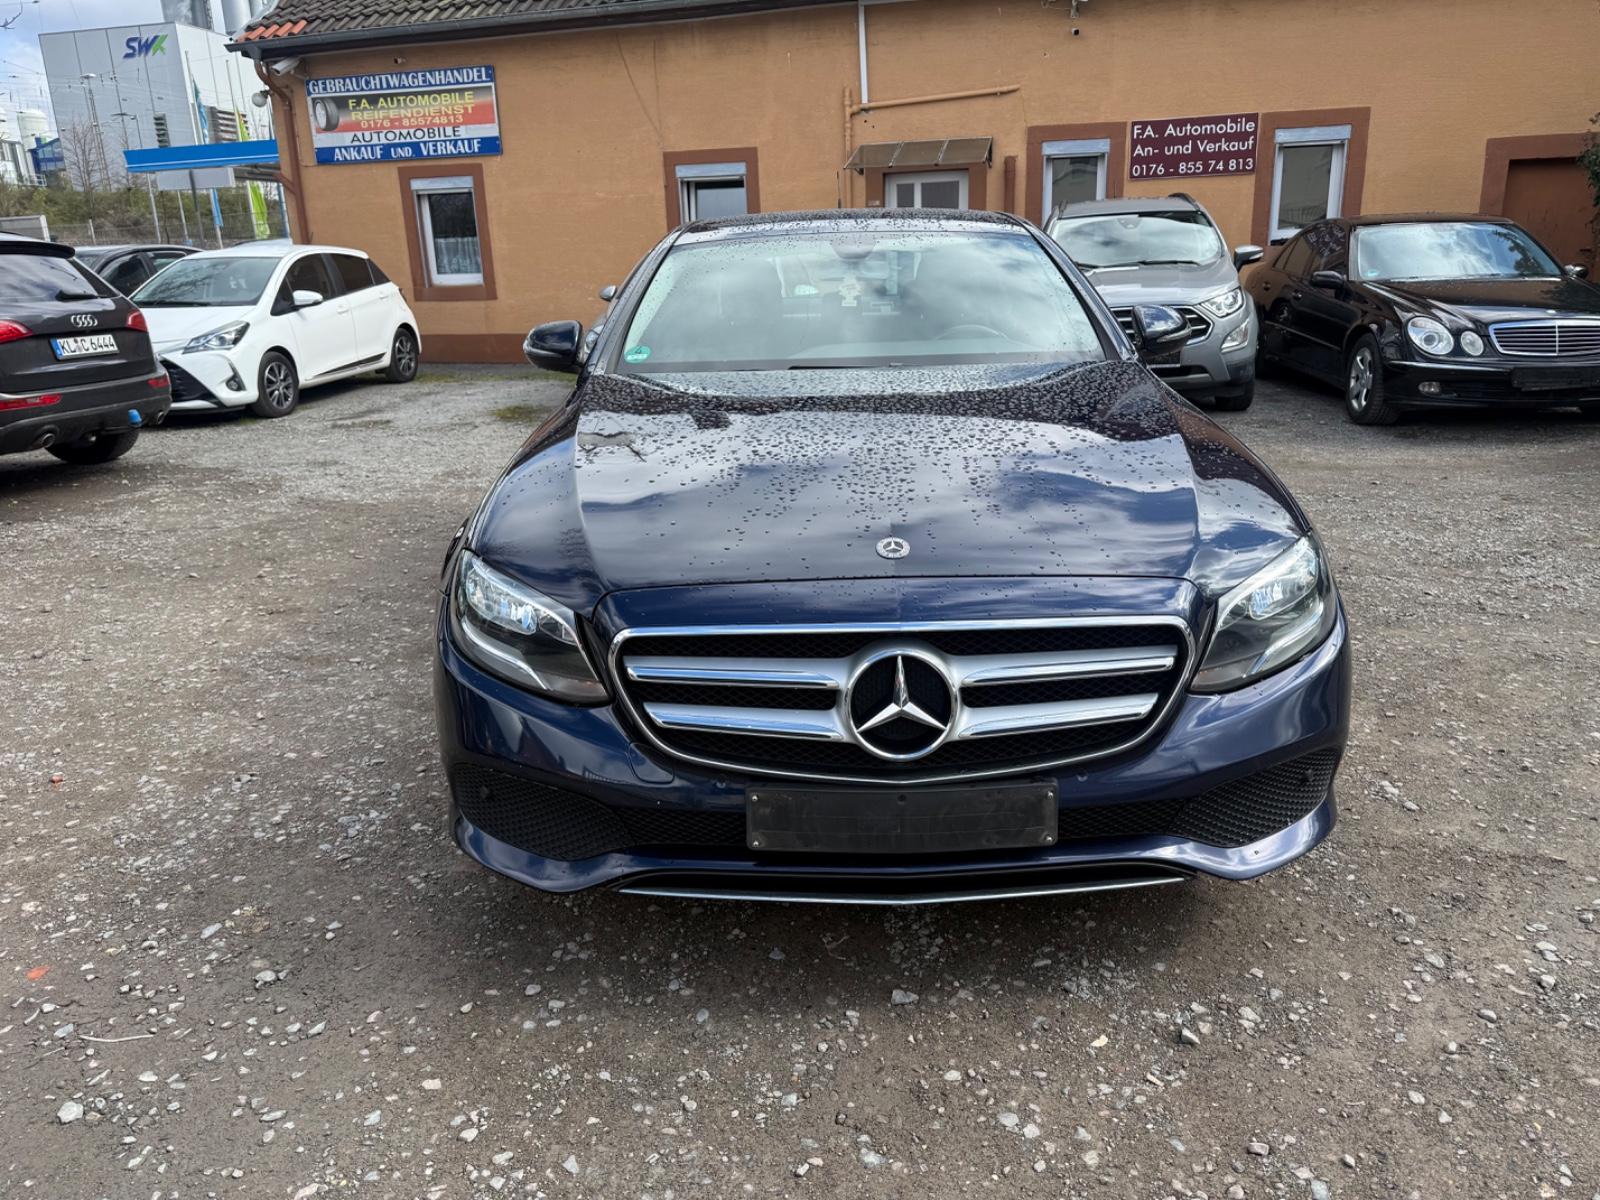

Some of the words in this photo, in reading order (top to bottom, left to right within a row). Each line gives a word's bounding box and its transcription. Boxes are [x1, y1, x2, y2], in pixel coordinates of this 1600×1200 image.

[123, 34, 168, 59] SWK
[309, 67, 490, 94] GEBRAUCHTWAGENHANDEL
[348, 99, 374, 110] F.A.
[378, 91, 474, 109] AUTOMOBILE
[351, 104, 475, 121] REIFENDIENST
[361, 119, 390, 128] 0176
[402, 115, 463, 126] 85574813
[351, 126, 461, 143] AUTOMOBILE
[1133, 125, 1158, 139] F.A.
[1164, 117, 1255, 137] Automobile
[334, 145, 383, 161] ANKAUF
[391, 148, 412, 157] UND
[420, 139, 481, 156] VERKAUF
[1133, 144, 1159, 157] An-
[1164, 140, 1192, 155] und
[1197, 136, 1255, 152] Verkauf
[1132, 164, 1165, 176] 0176
[1179, 161, 1203, 174] 855
[1208, 160, 1224, 172] 74
[1228, 158, 1253, 171] 813
[59, 340, 77, 354] KL
[90, 336, 115, 351] 6444
